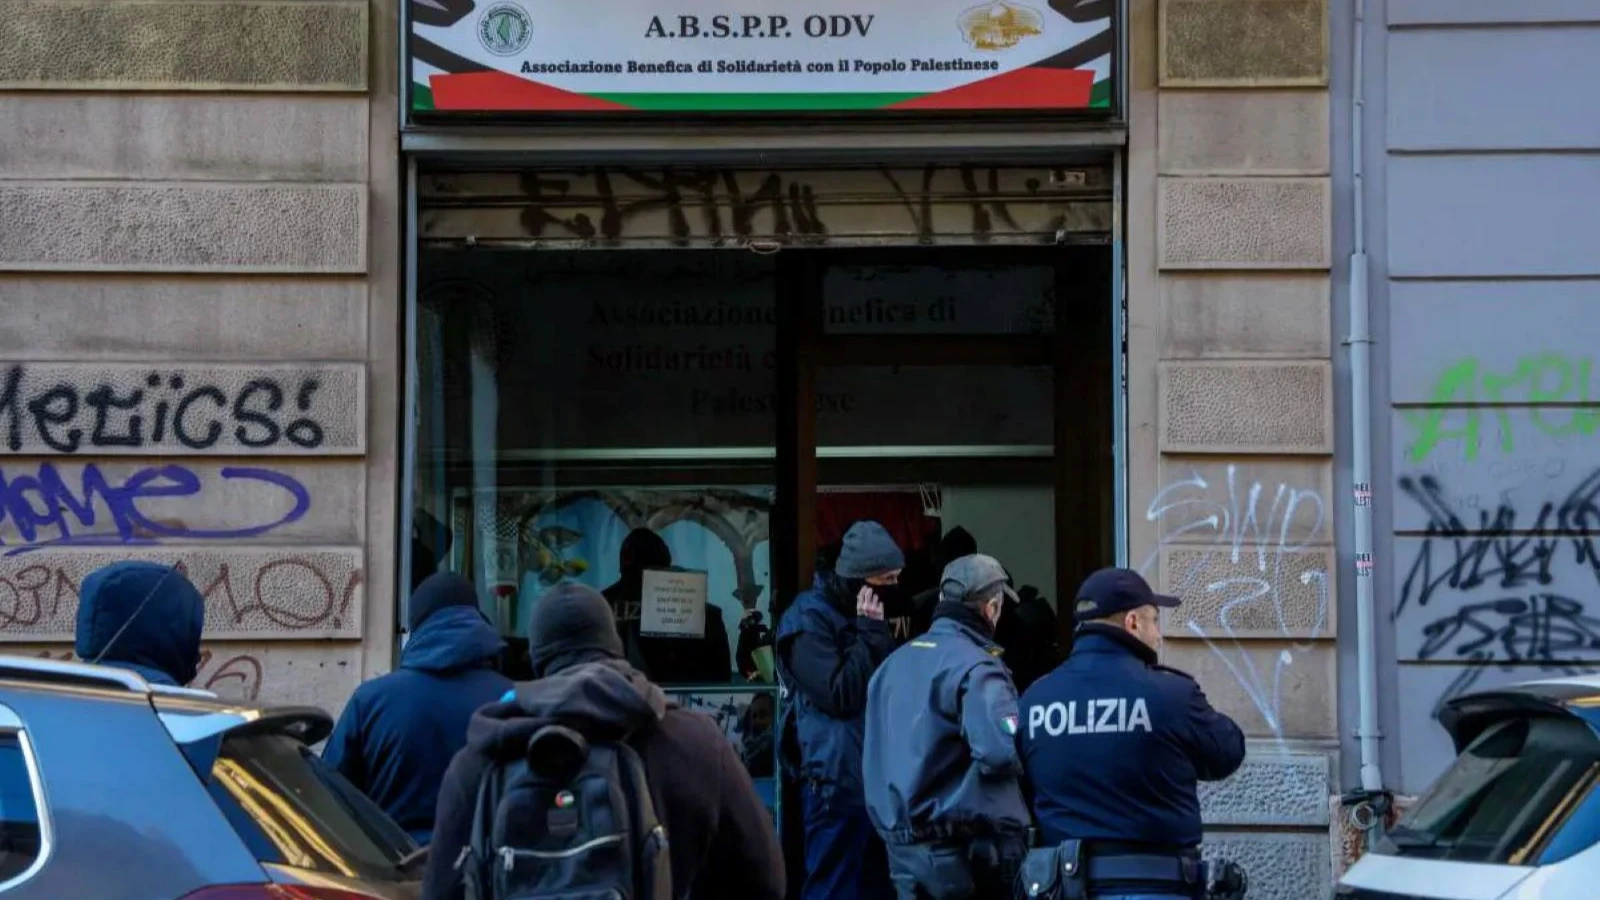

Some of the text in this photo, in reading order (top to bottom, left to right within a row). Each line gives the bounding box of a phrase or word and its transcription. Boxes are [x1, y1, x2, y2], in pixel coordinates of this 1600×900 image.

[645, 14, 875, 38] A.B.S.P.P. ODV
[521, 57, 999, 75] Associazione Benefica di Solidarietà con il Popolo Palestinese
[1028, 697, 1152, 740] POLIZIA
